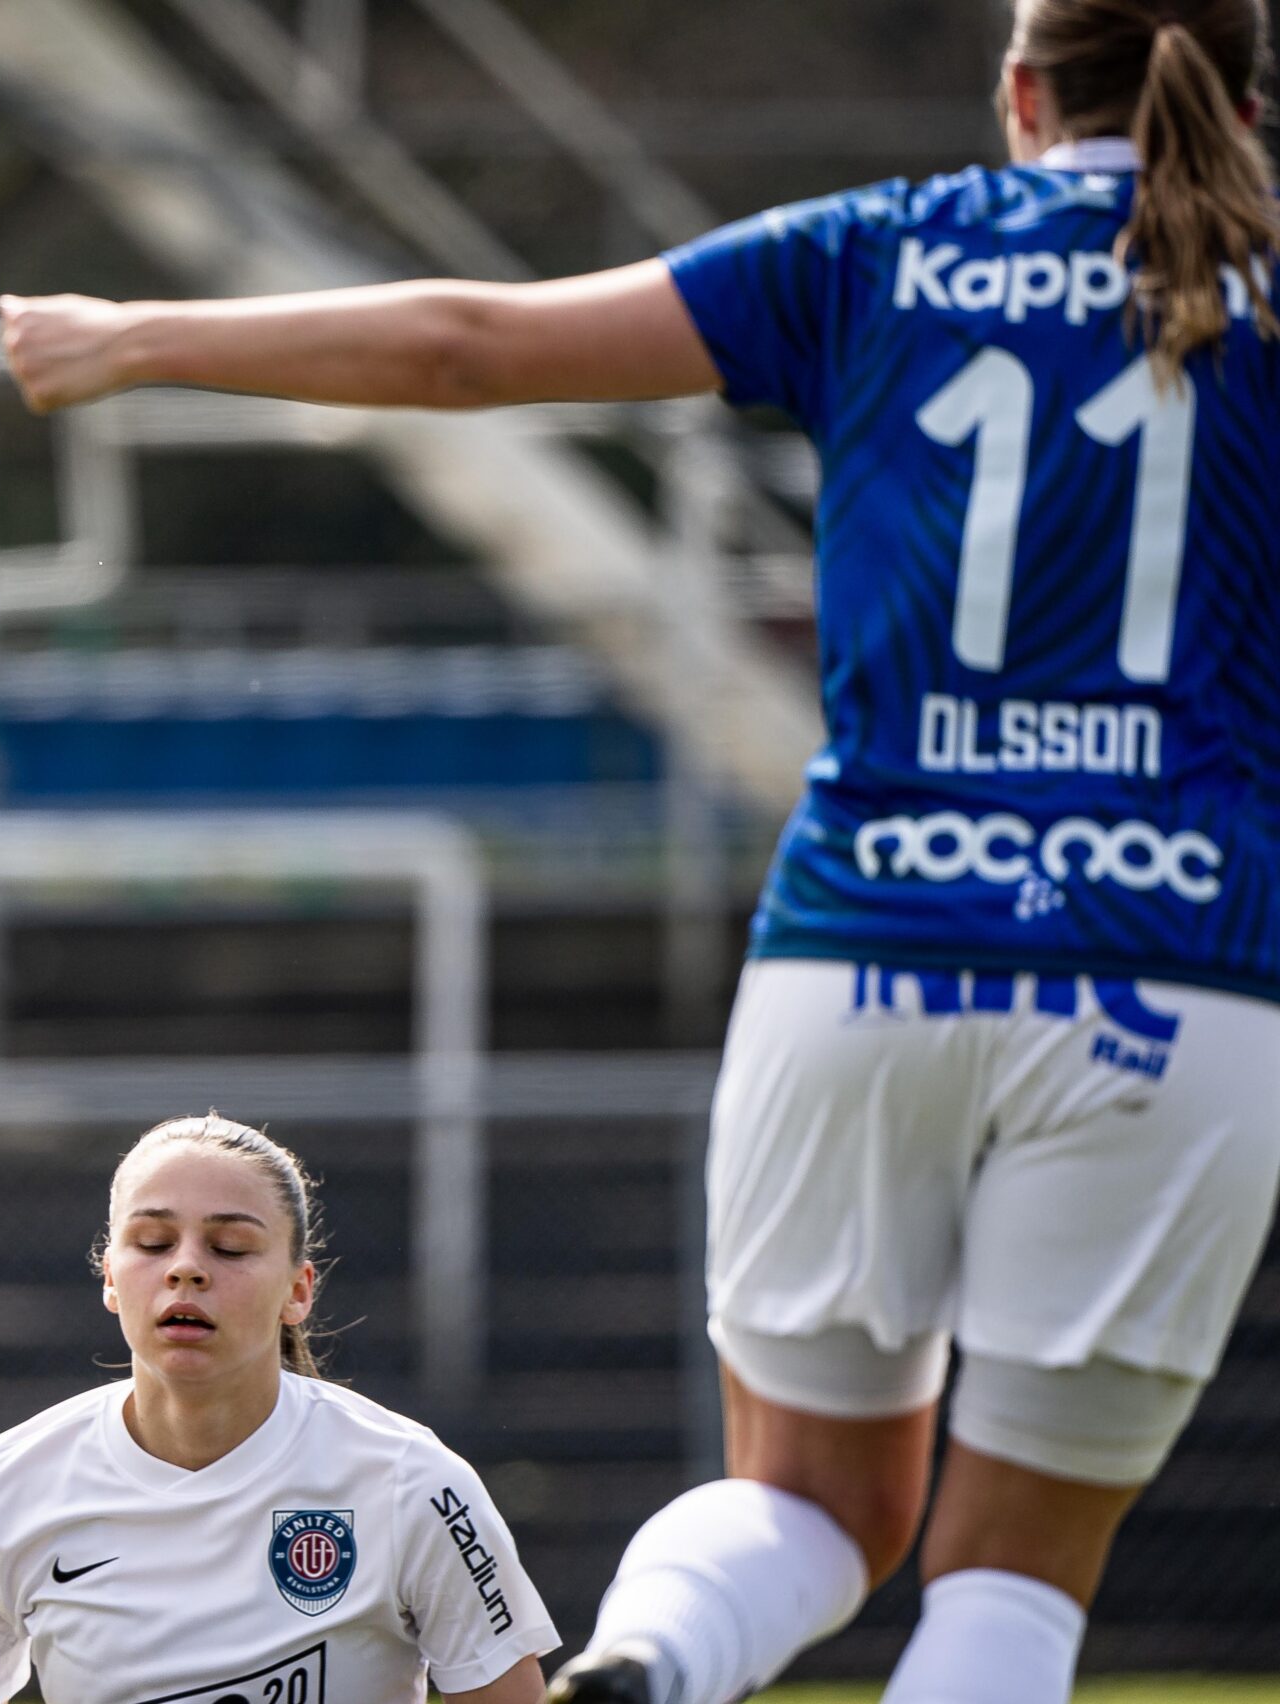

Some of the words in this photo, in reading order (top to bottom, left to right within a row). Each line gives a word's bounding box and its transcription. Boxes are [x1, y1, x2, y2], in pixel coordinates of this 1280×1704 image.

[915, 346, 1197, 685] 11
[920, 693, 1162, 779] OLSSON
[1091, 1032, 1170, 1084] Rail
[281, 1516, 345, 1538] UNITED
[286, 1576, 340, 1594] ESKILSTUNA
[430, 1487, 514, 1636] stadium
[263, 1667, 308, 1704] 20
